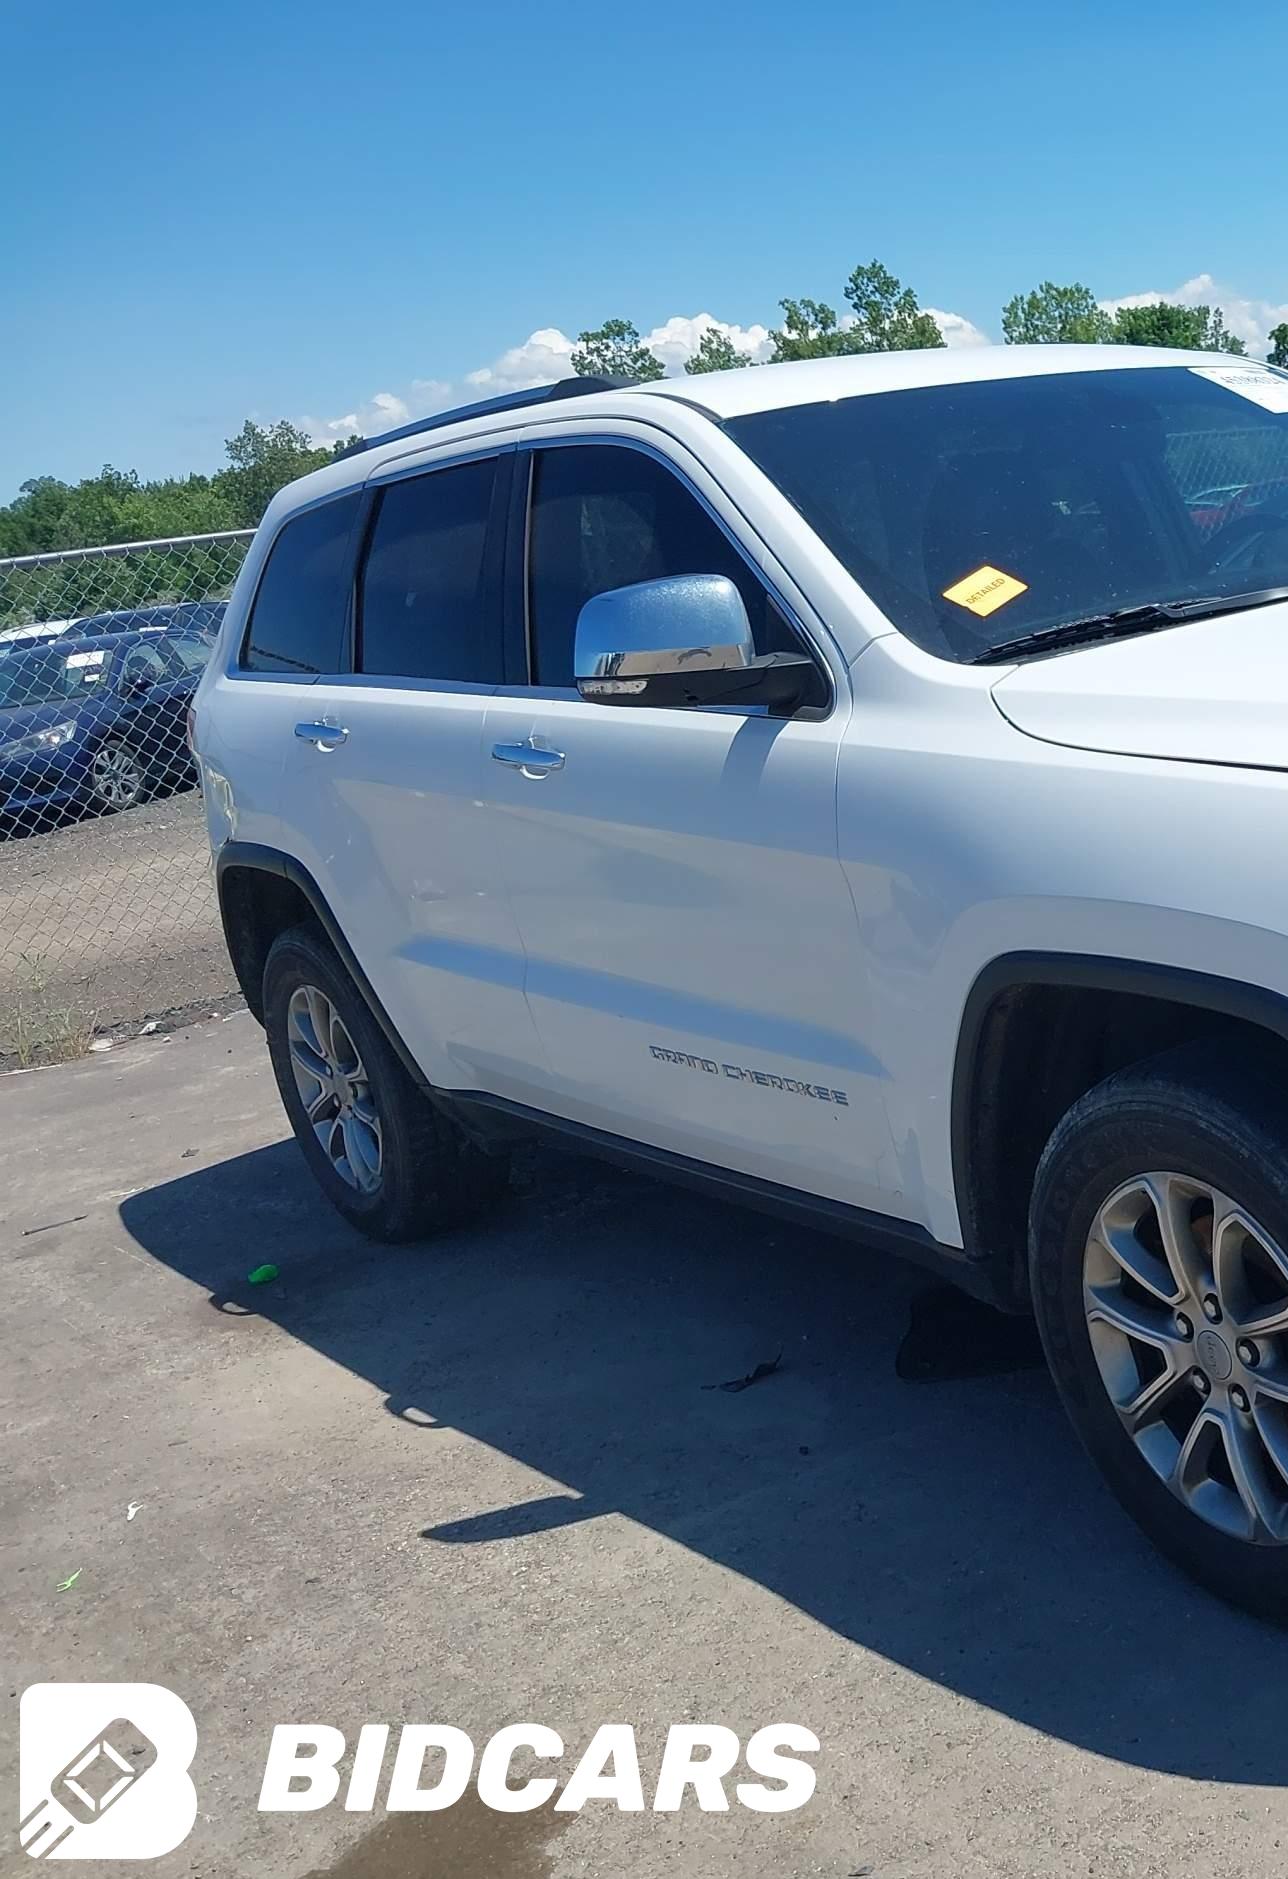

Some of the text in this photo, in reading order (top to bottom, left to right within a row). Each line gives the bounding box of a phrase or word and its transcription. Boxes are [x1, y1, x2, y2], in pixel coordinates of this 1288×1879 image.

[965, 578, 1006, 605] DETAILED
[649, 1045, 849, 1107] GRAND CHEROKEE
